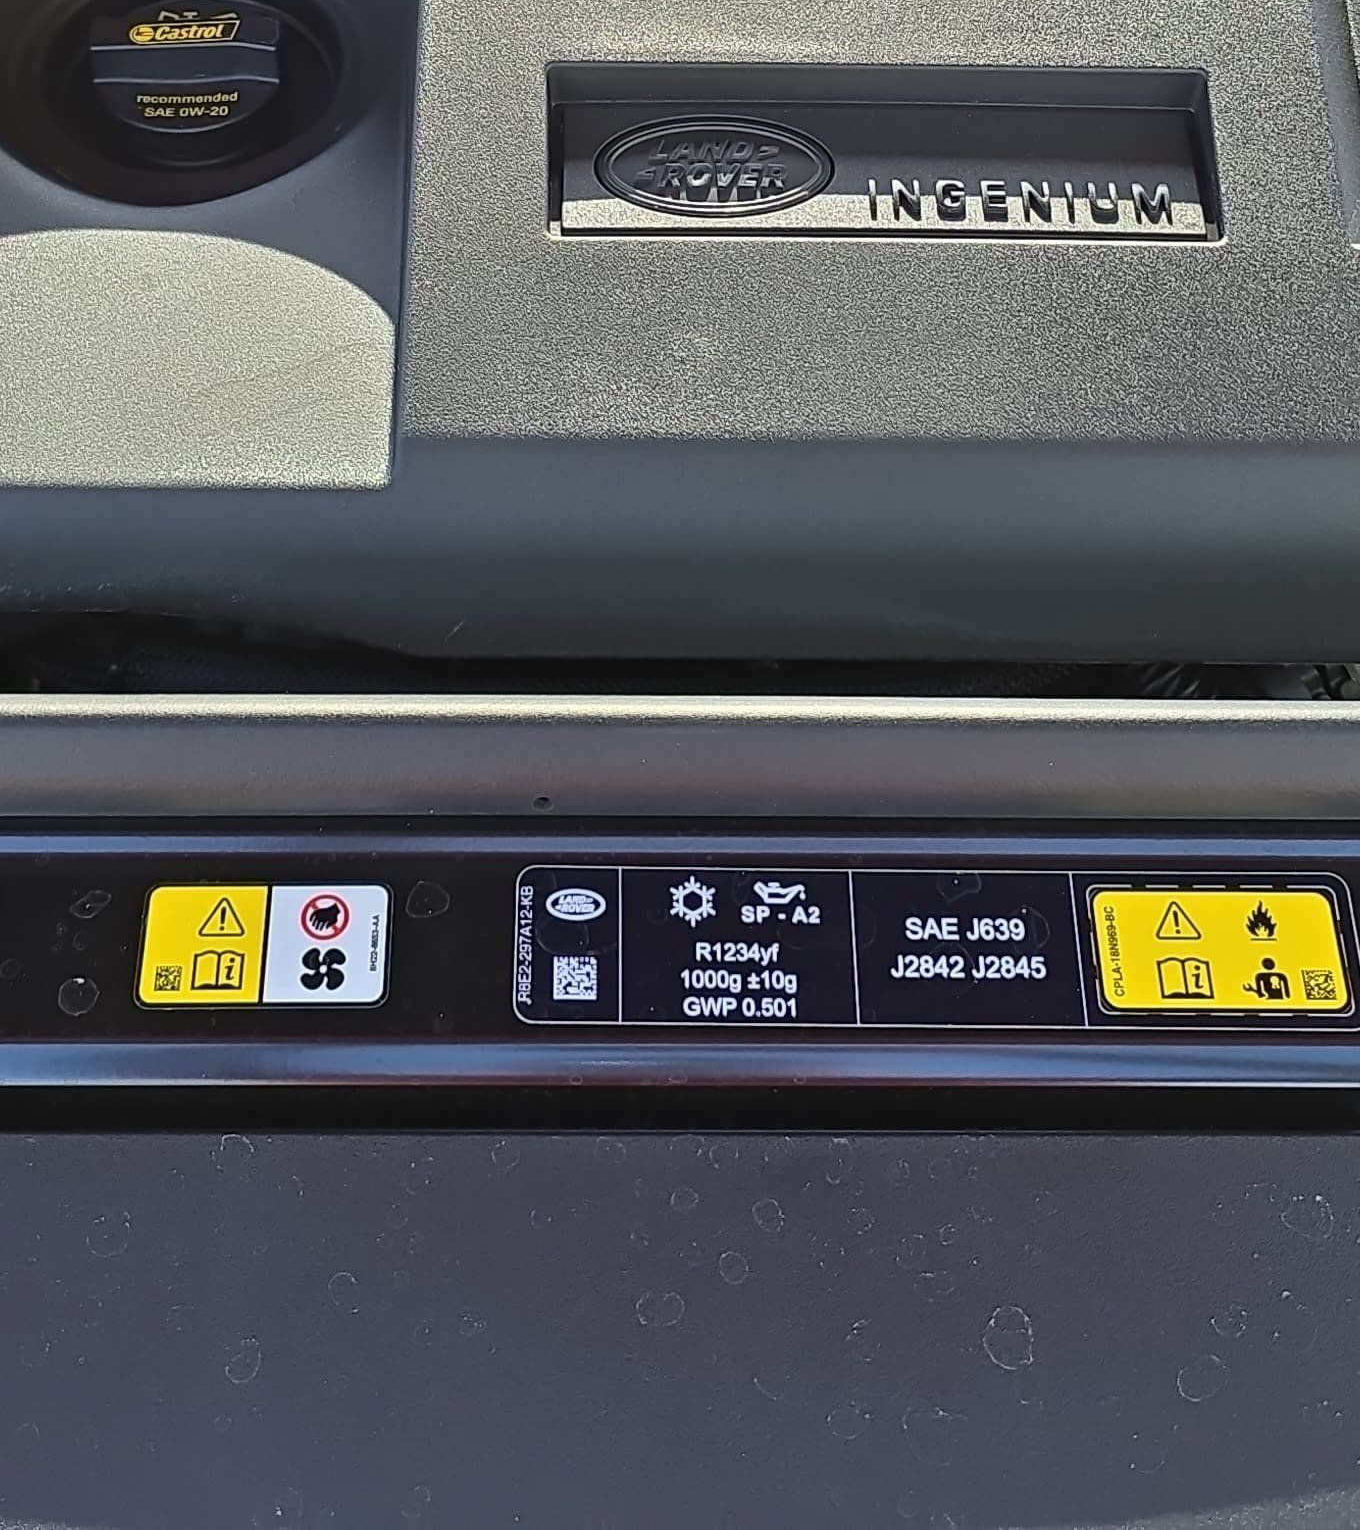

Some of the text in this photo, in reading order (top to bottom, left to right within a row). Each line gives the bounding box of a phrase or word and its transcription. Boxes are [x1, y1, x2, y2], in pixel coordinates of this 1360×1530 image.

[155, 24, 224, 41] Castrol
[136, 92, 239, 104] recommended
[144, 105, 229, 117] SAE 0W-20
[648, 138, 755, 162] LAND
[657, 162, 787, 188] ROVER
[867, 178, 1173, 225] INGENIUM
[559, 895, 587, 904] LAND
[560, 904, 596, 914] ROVER
[741, 906, 772, 924] SP
[791, 906, 821, 924] A2
[905, 917, 1025, 941] SAE J639
[695, 942, 780, 965] R1234yf
[890, 955, 1047, 980] J2842 J2845
[680, 971, 798, 994] 1000g ±10g
[683, 997, 798, 1018] GWP 0.501
